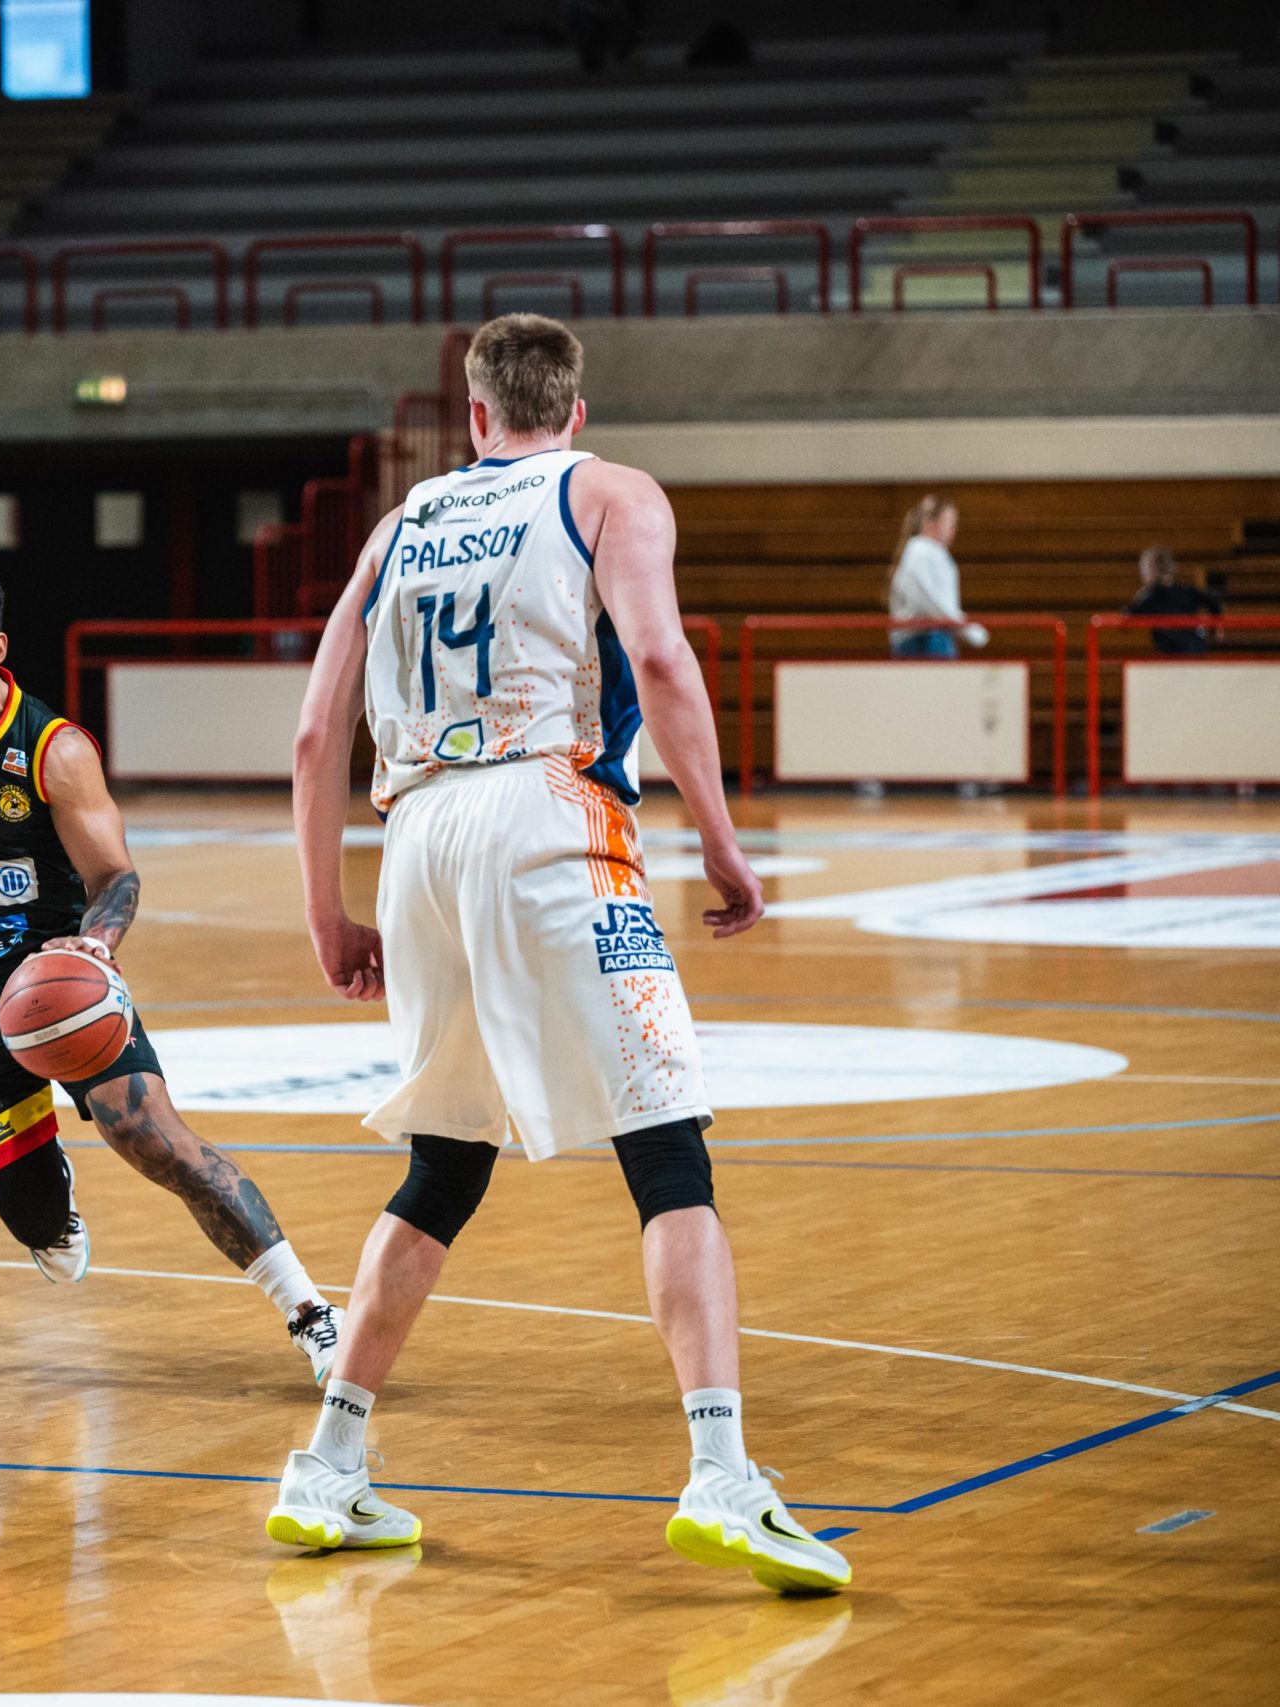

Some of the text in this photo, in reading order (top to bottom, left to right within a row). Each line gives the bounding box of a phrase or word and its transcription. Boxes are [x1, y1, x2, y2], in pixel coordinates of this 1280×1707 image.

[440, 475, 546, 508] OIKODOMEO
[417, 582, 495, 714] 14
[595, 936, 664, 954] BASKE
